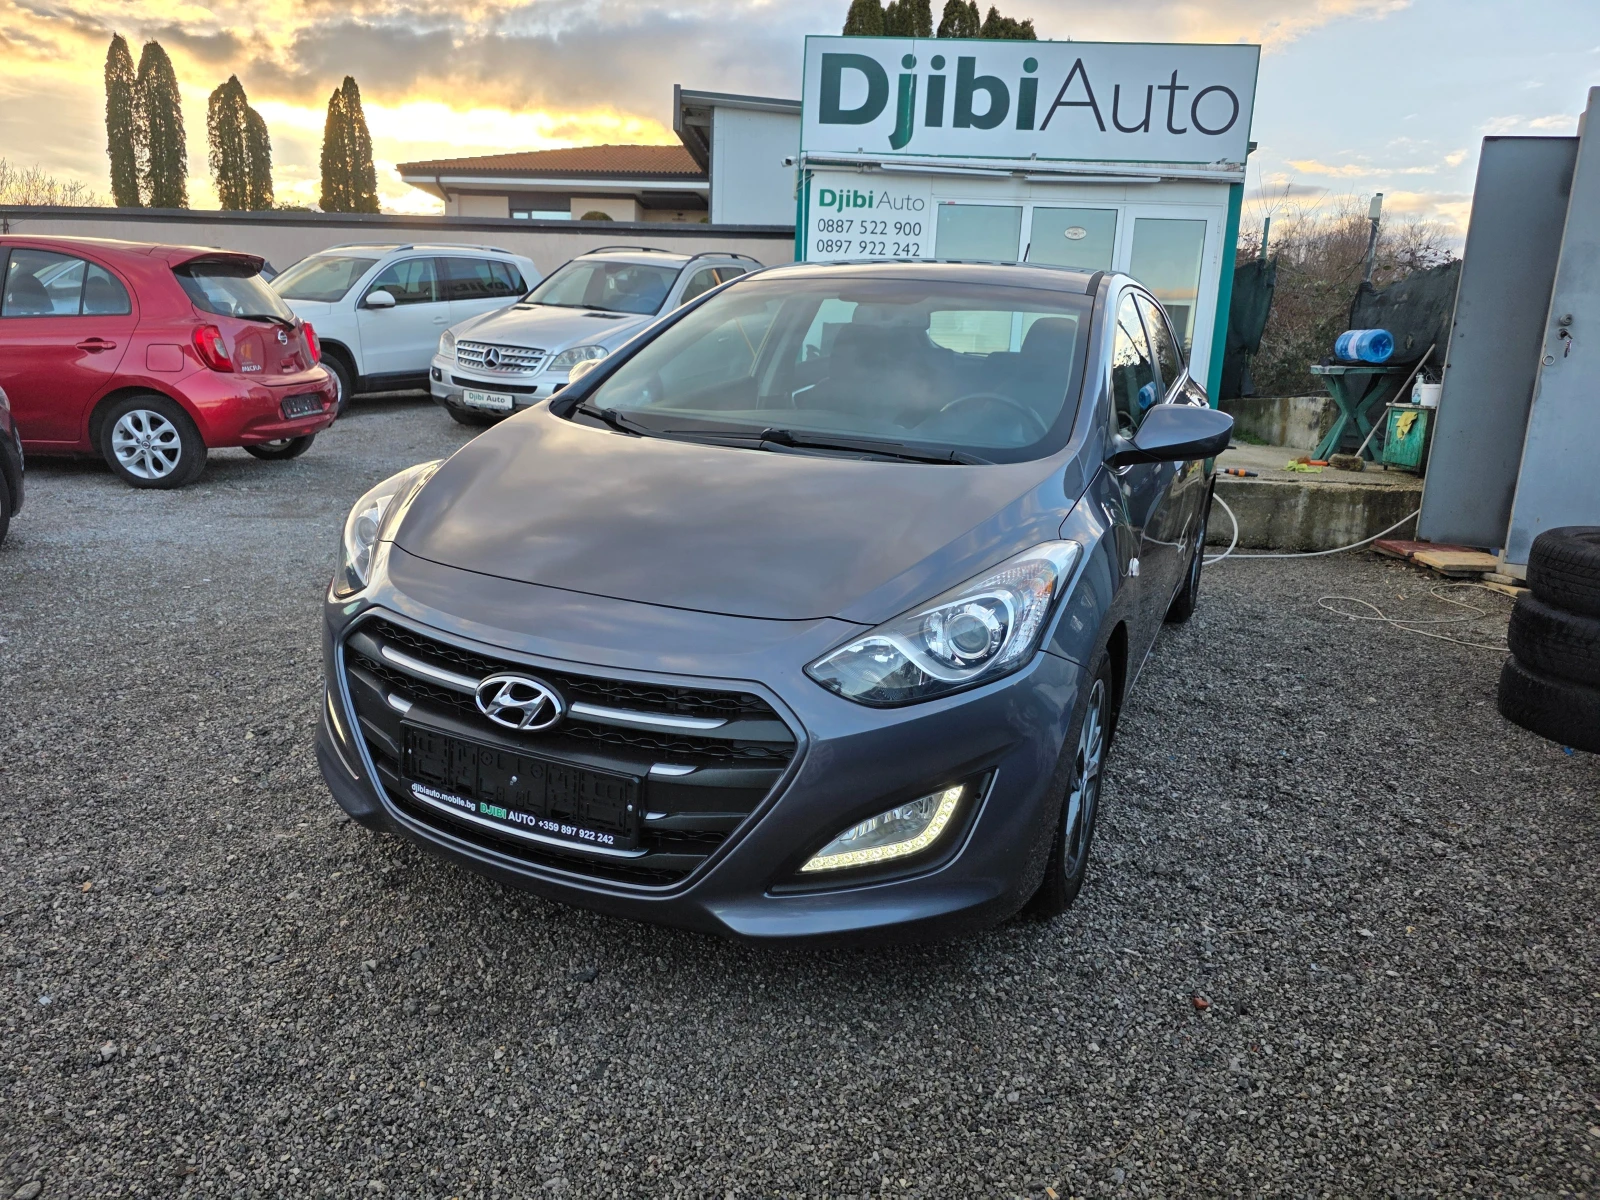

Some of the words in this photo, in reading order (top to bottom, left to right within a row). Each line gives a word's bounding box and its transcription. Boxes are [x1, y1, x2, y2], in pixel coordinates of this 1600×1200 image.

[817, 218, 854, 233] 0887
[859, 220, 888, 235] 522
[893, 221, 922, 236] 900
[816, 239, 852, 254] 0897
[858, 240, 886, 256] 922
[892, 241, 920, 257] 242
[468, 392, 485, 402] Djibi
[486, 394, 506, 404] Auto
[480, 802, 507, 820] DJIBI
[508, 811, 536, 826] AUTO
[538, 820, 560, 832] +359
[561, 825, 578, 837] 897
[578, 829, 596, 841] 922
[597, 833, 614, 845] 242
